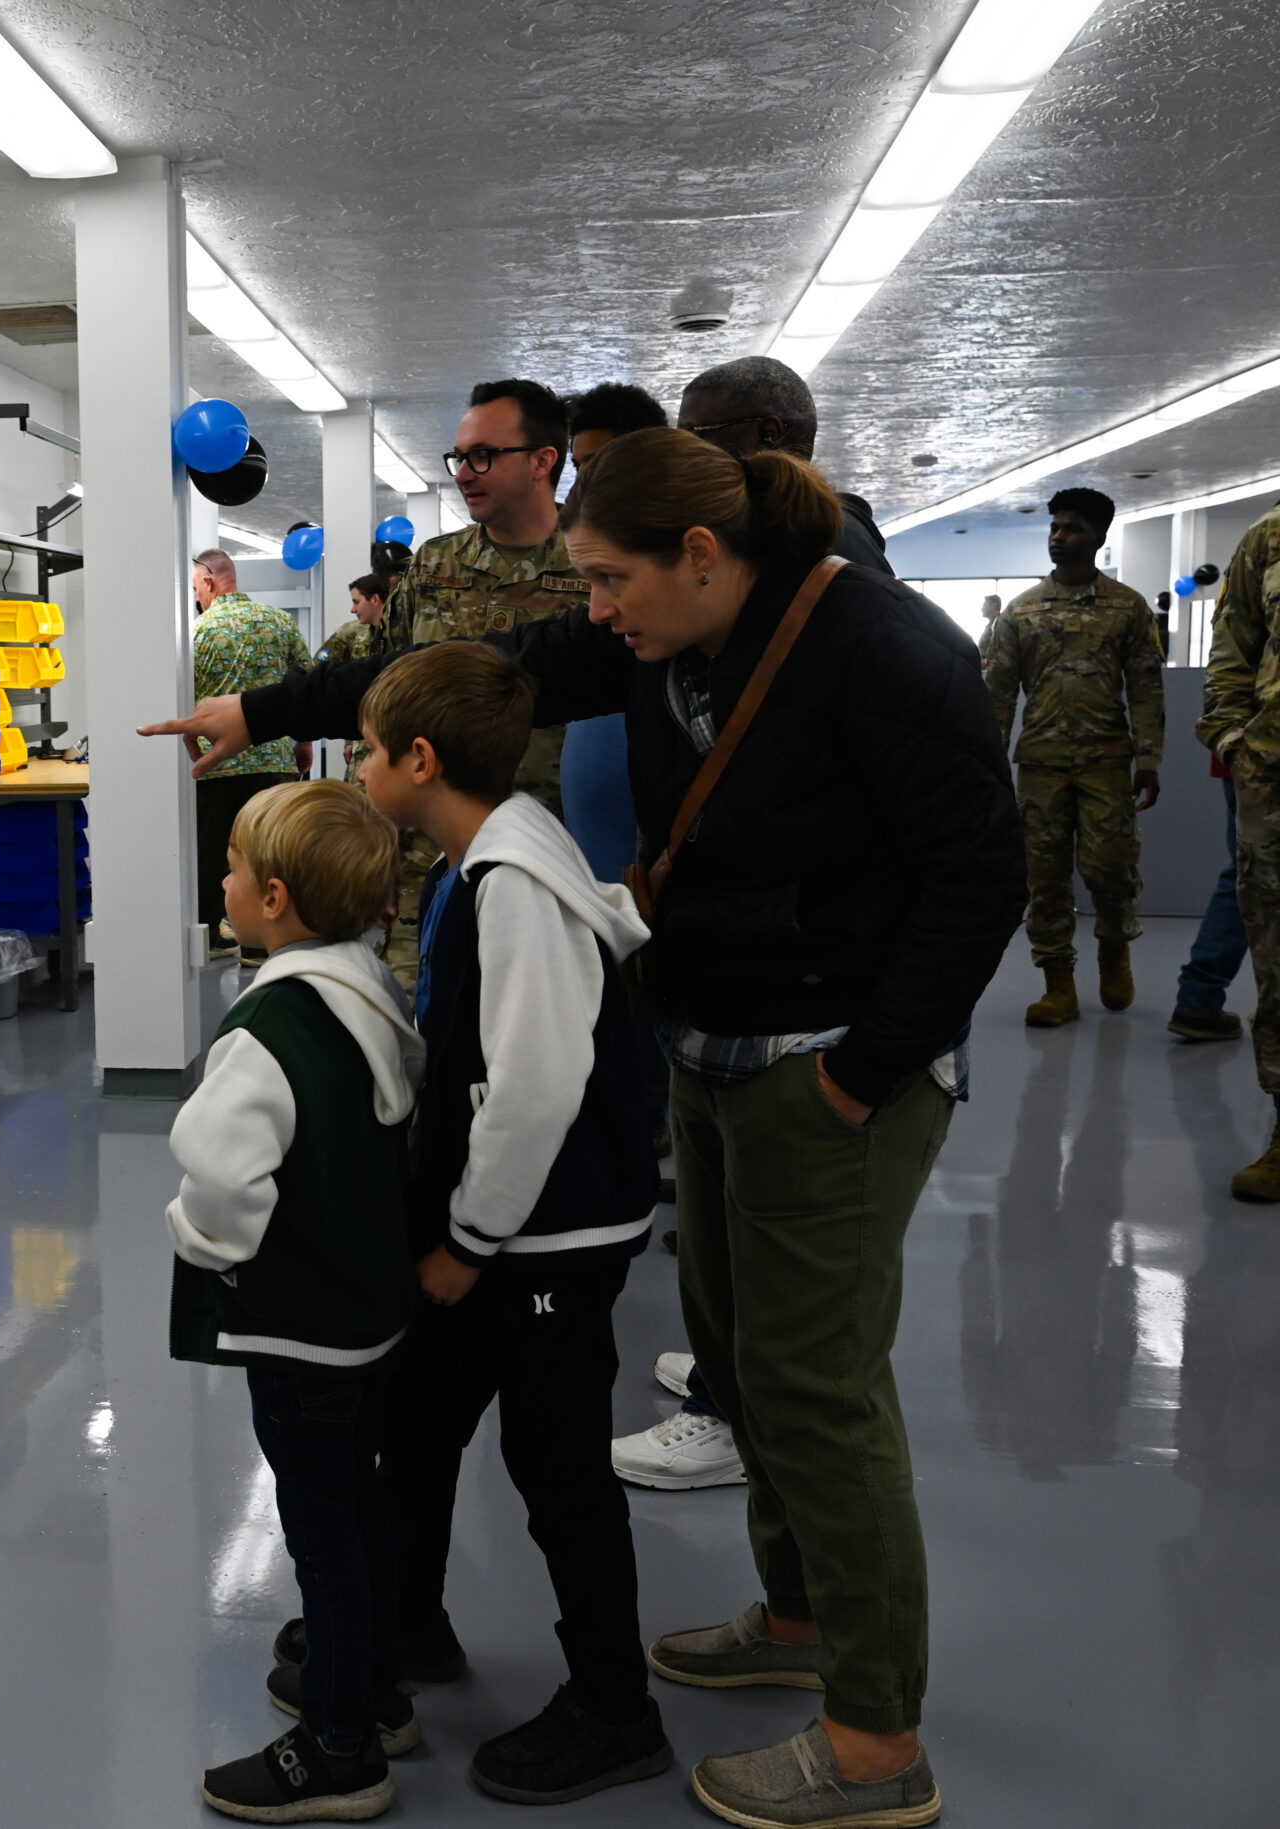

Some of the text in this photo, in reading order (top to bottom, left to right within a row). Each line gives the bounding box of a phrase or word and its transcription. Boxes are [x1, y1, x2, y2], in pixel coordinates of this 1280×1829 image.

[544, 577, 592, 591] U.S. AIR FOR
